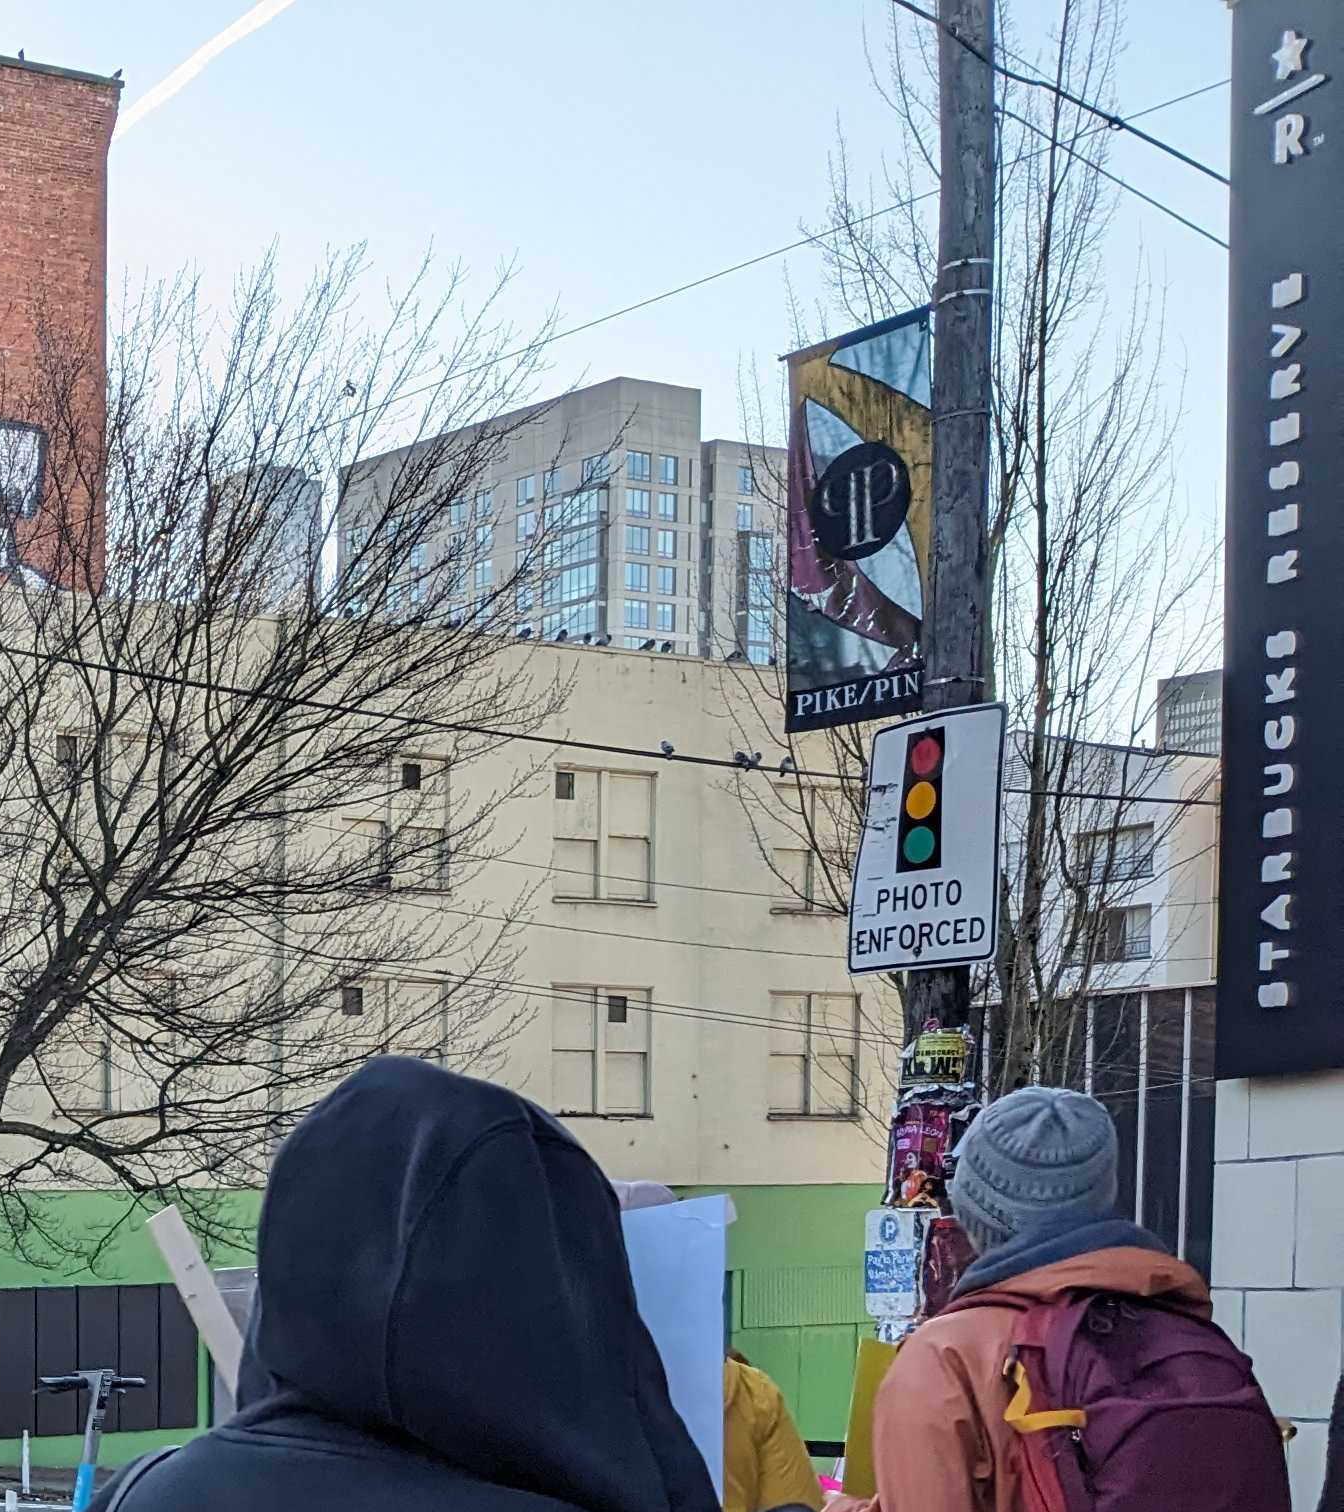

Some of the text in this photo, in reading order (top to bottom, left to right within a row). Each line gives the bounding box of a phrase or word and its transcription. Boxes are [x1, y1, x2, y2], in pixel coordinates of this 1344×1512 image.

[1257, 272, 1304, 1009] STARBUCKS RESERVE
[794, 671, 921, 716] PIKE/PIN
[876, 879, 962, 915] PHOTO
[855, 916, 986, 956] ENFORCED
